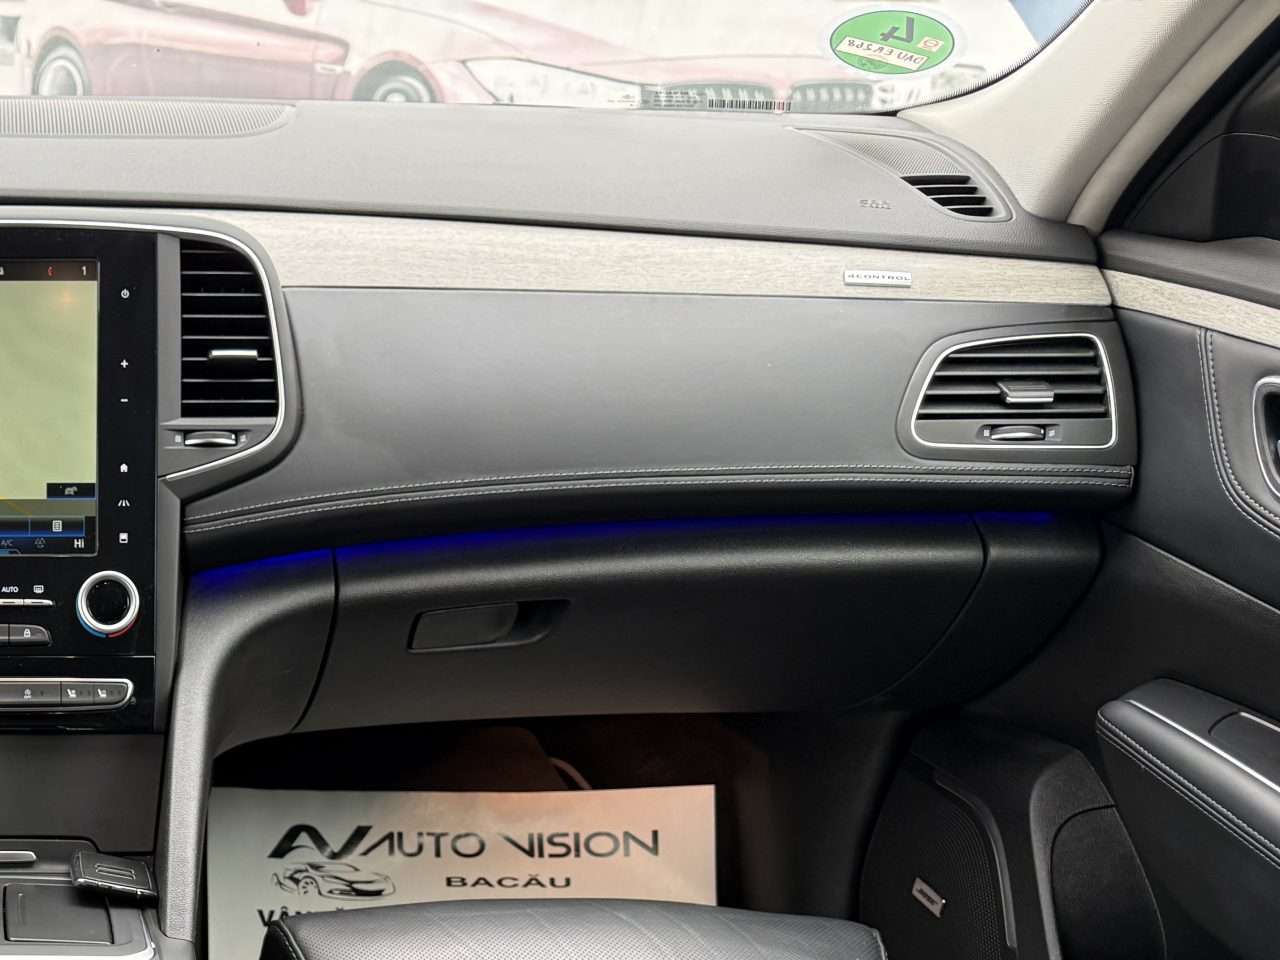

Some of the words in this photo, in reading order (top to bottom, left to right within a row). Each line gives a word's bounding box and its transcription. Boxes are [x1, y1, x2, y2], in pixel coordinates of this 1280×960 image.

[1, 585, 19, 593] AUTO
[496, 829, 660, 859] VISION
[444, 873, 572, 889] BACĂU
